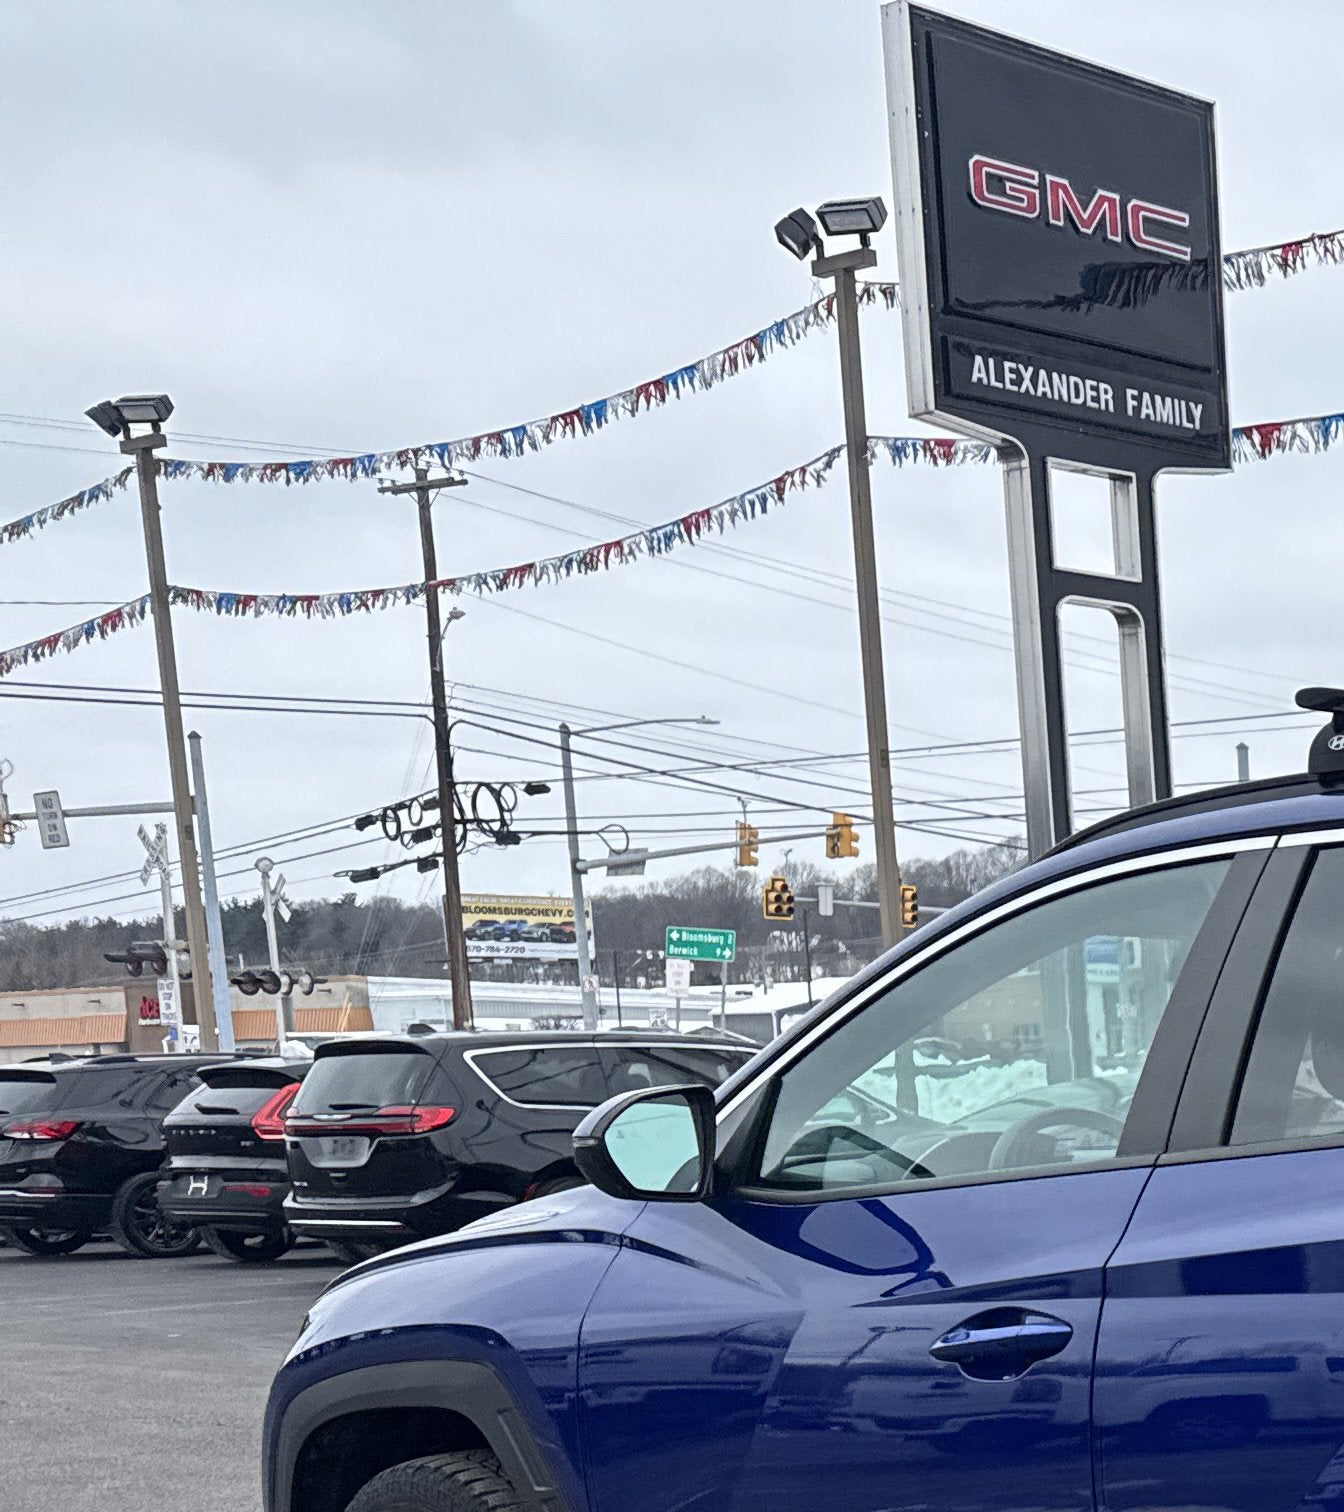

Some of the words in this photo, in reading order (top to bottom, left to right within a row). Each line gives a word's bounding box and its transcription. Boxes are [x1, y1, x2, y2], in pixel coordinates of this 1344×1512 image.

[968, 154, 1191, 261] GMC
[971, 354, 1114, 414] ALEXANDER
[1126, 388, 1203, 430] FAMILY
[42, 797, 53, 809] NO
[48, 833, 60, 843] RED
[681, 931, 724, 945] Bloomsburg
